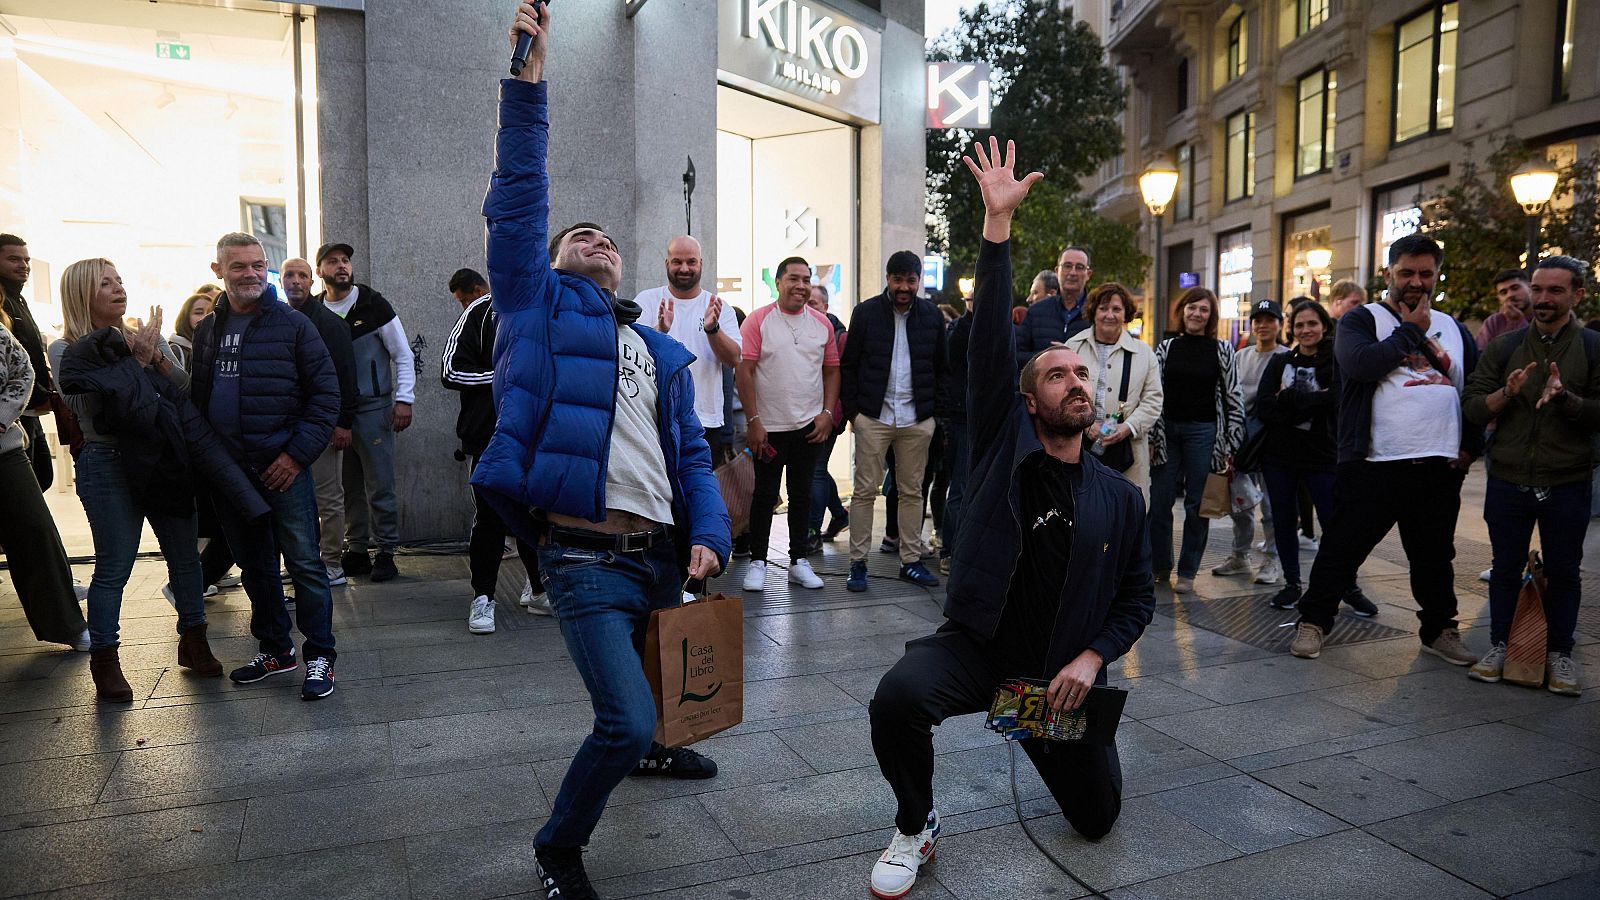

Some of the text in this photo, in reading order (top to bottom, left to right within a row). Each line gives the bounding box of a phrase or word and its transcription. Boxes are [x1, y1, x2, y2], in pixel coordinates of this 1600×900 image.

[748, 0, 868, 79] KIKO
[783, 61, 841, 95] MILANO
[623, 343, 657, 385] CLU
[690, 645, 713, 657] Casa
[702, 655, 714, 665] del
[690, 665, 714, 678] Libro
